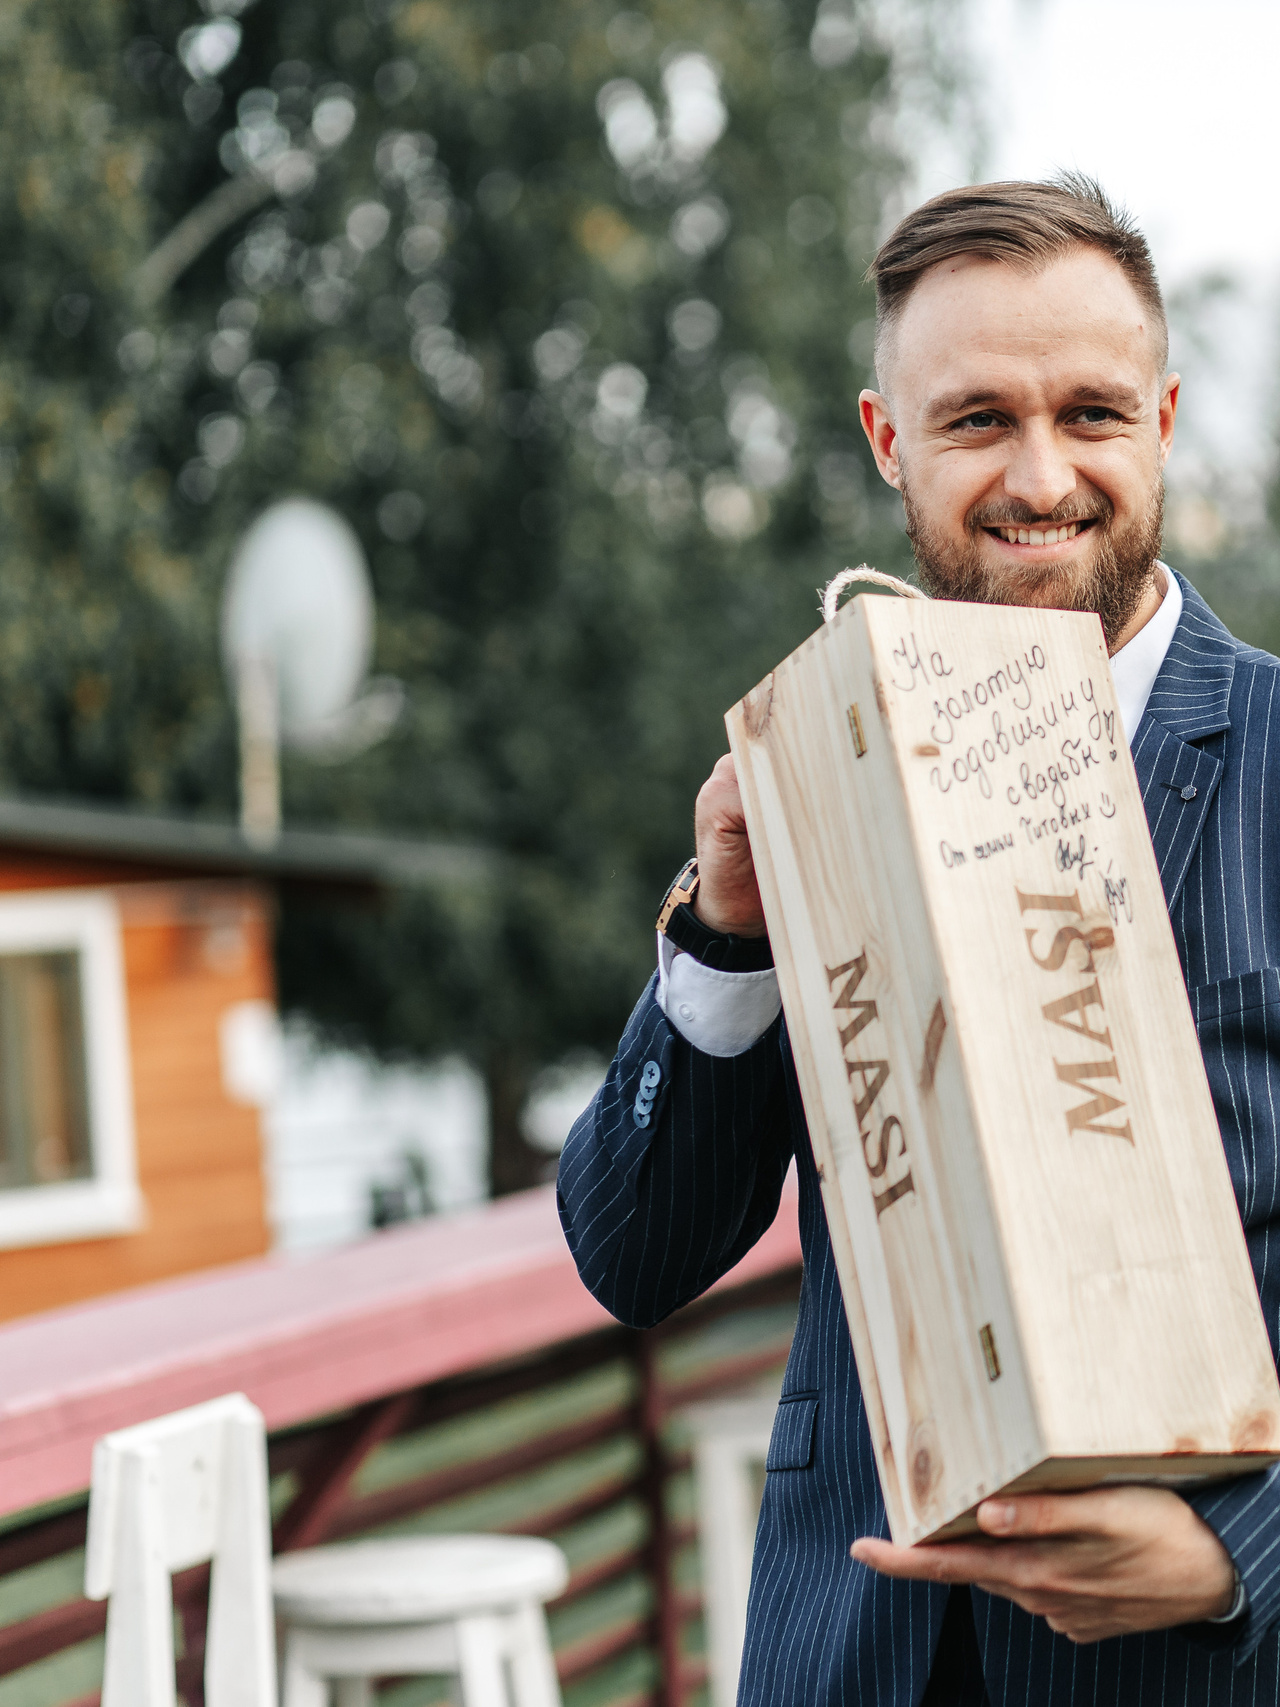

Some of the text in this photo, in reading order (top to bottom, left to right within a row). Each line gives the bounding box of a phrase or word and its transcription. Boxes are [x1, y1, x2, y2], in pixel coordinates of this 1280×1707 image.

[891, 632, 953, 692] На
[931, 645, 1046, 744] золотую
[939, 839, 967, 869] От
[1014, 883, 1136, 1148] MASI
[825, 944, 917, 1218] MASI
